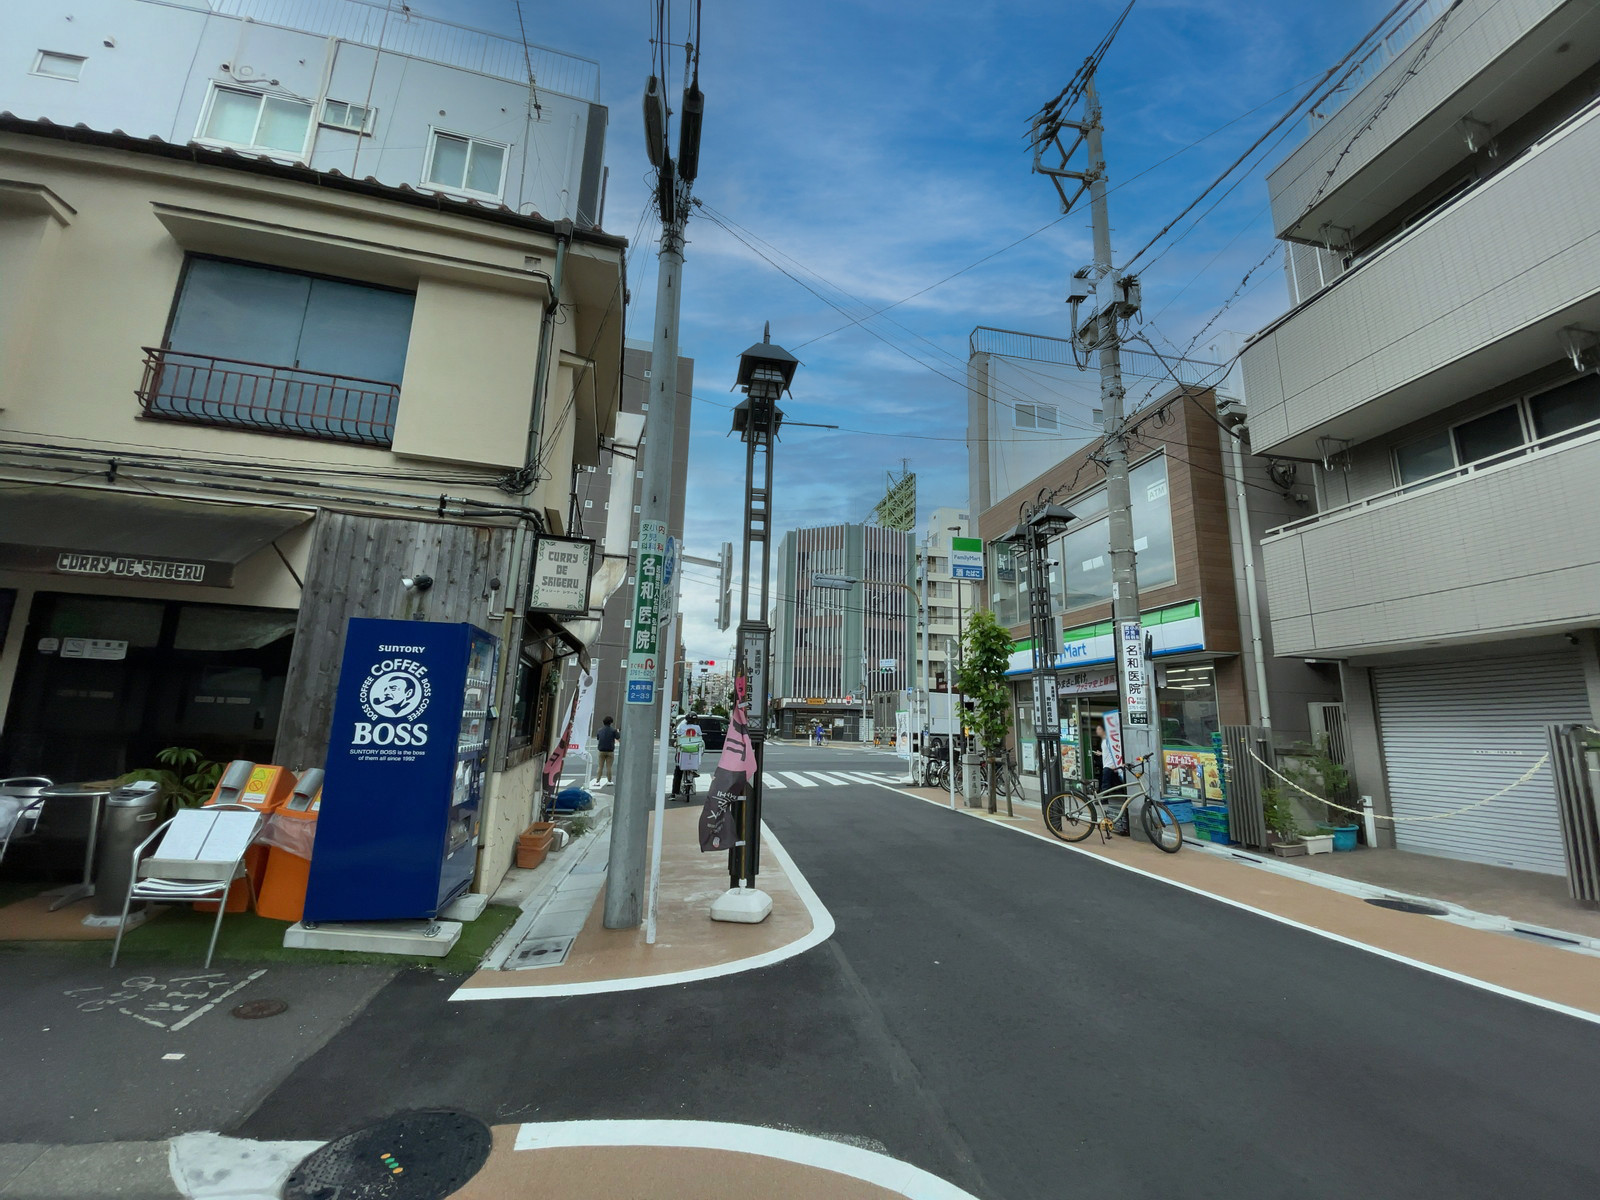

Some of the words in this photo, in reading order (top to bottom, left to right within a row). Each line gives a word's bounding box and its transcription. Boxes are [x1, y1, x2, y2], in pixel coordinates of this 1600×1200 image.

[1150, 486, 1165, 500] ATM
[548, 551, 579, 564] CURRY
[57, 553, 112, 573] CURRY
[114, 558, 138, 576] DE
[139, 560, 206, 582] SHIGERU
[556, 565, 568, 576] DE
[965, 569, 980, 577] たばこ
[541, 576, 579, 589] SHIGERU
[635, 557, 656, 650] 名和医院
[378, 644, 426, 654] SUNTORY
[371, 658, 428, 678] COFFEE
[1126, 645, 1141, 694] 名和医院
[359, 675, 375, 703] COFFEE
[420, 678, 432, 697] BOSS
[361, 703, 379, 721] BOSS
[407, 698, 430, 722] COFFEE
[351, 722, 428, 746] BOSS
